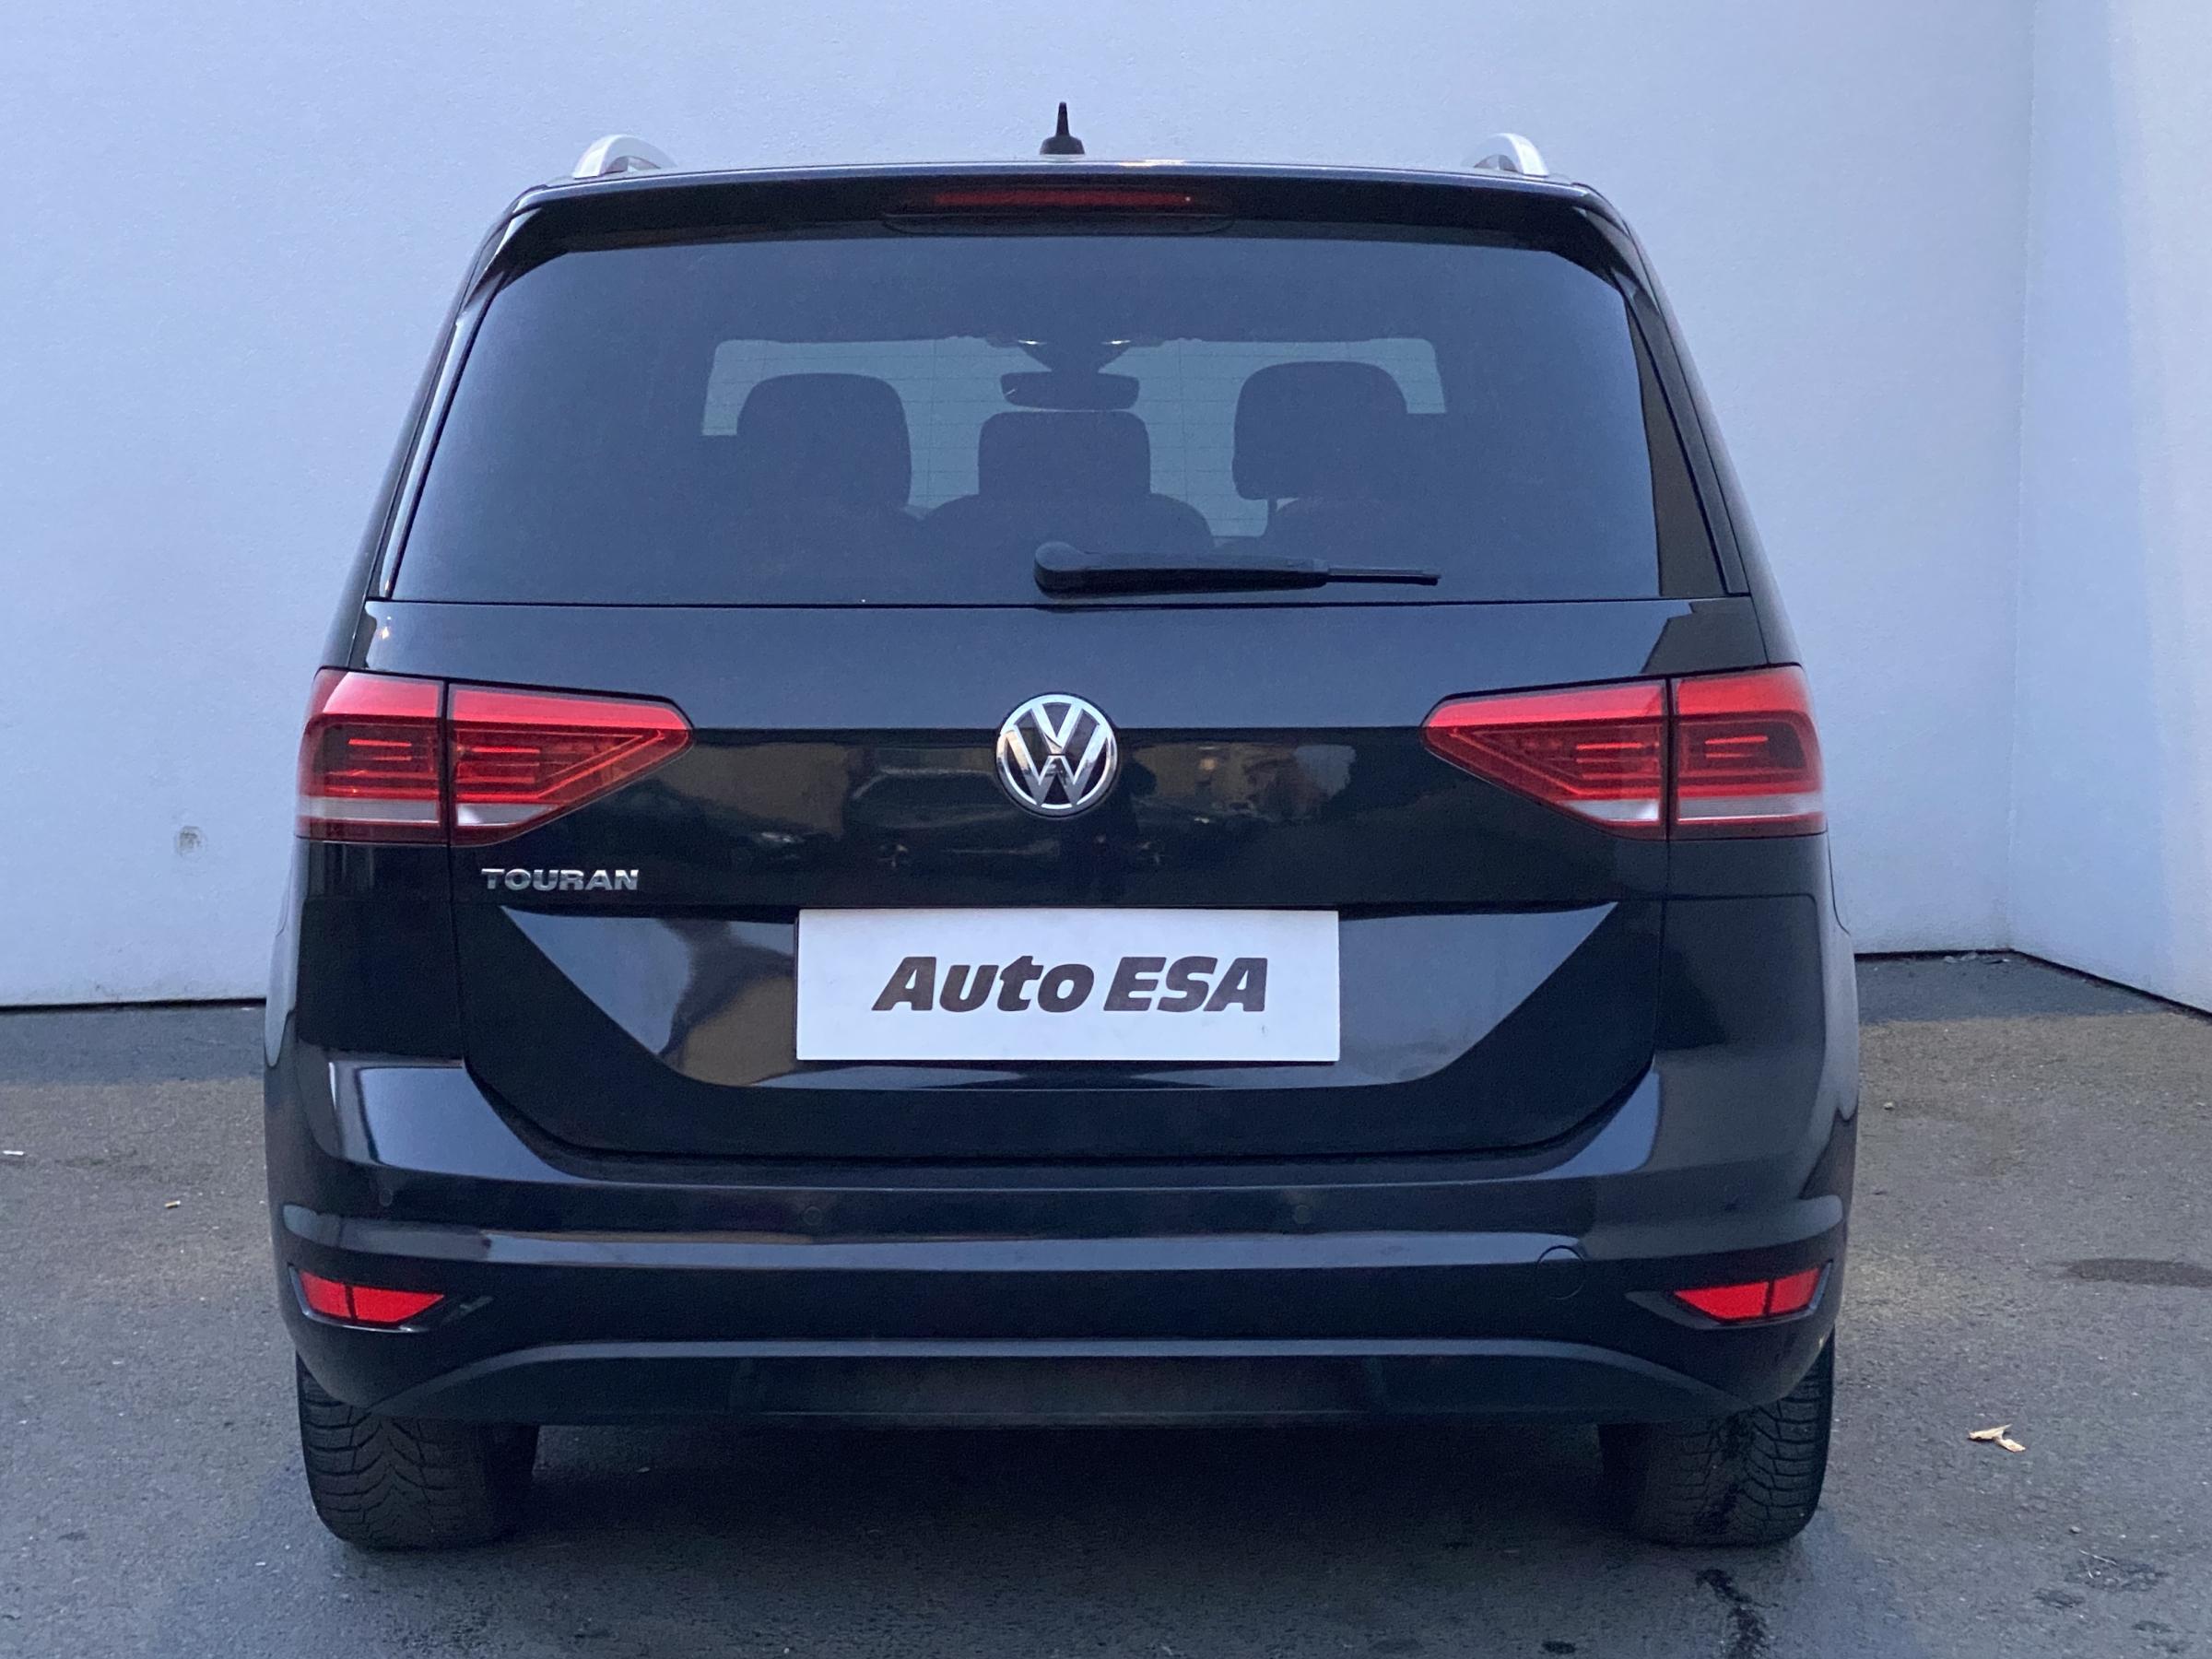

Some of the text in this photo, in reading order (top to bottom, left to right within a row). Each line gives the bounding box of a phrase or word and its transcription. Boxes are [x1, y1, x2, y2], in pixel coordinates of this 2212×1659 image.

[999, 698, 1114, 812] VW
[480, 867, 640, 891] TOURAN
[870, 955, 1269, 1013] Auto ESA
